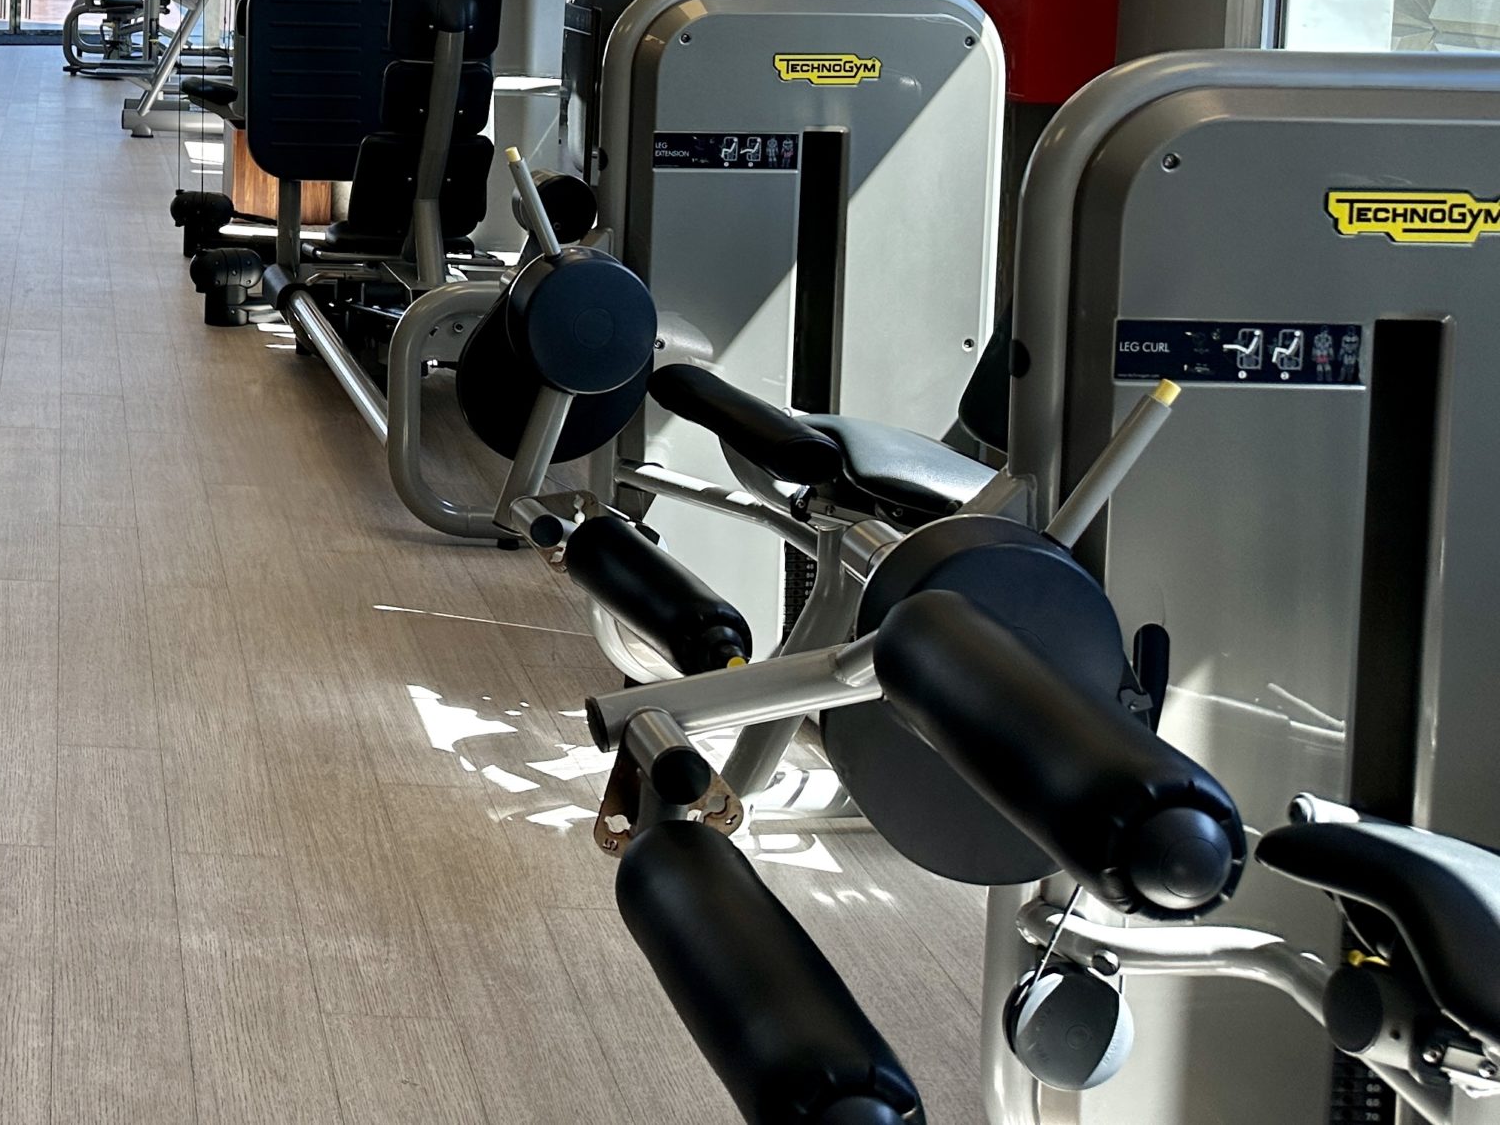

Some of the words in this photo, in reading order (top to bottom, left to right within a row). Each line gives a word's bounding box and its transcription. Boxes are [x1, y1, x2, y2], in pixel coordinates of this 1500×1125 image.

[655, 141, 668, 149] LEG
[654, 149, 690, 158] EXTENSION
[1119, 341, 1140, 353] LEG
[1142, 341, 1170, 353] CURL
